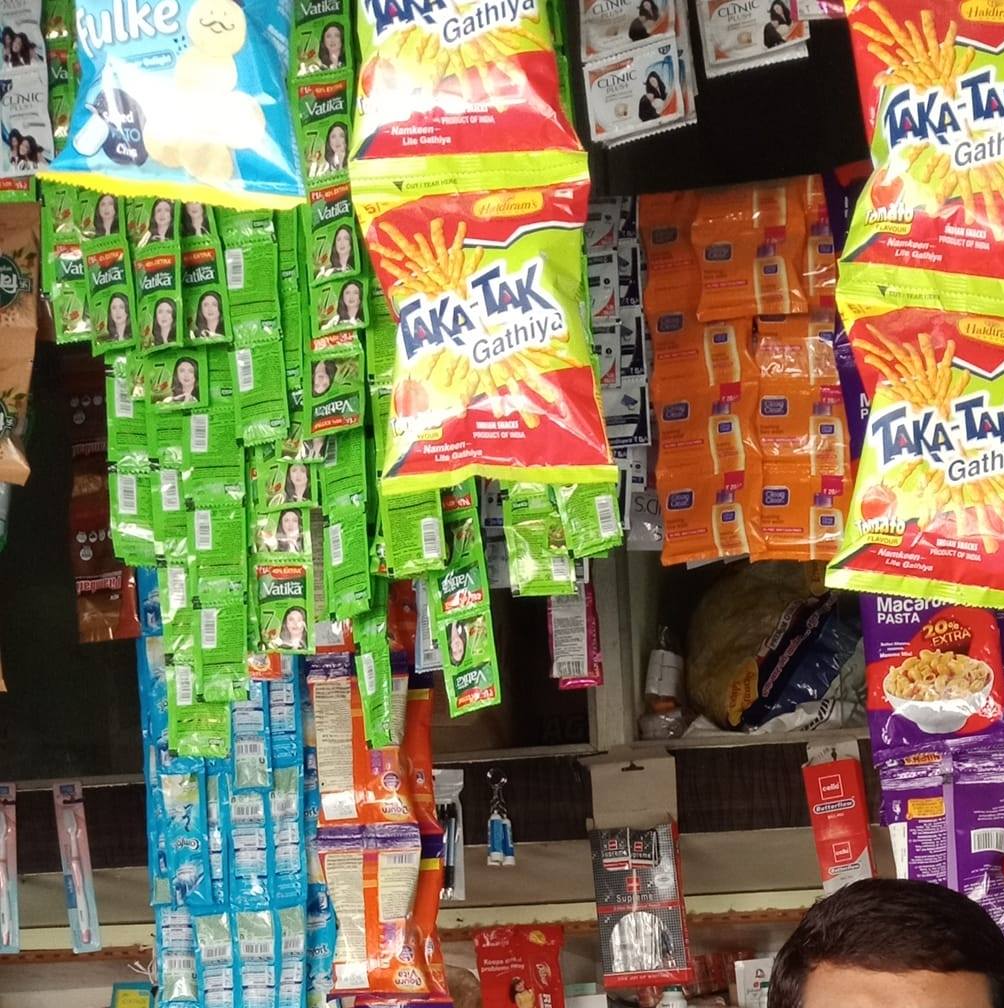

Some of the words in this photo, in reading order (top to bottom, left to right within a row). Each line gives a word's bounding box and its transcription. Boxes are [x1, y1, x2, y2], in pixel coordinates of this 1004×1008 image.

[301, 1, 340, 17] Vatika
[717, 2, 759, 18] CLINIC
[443, 0, 535, 43] Gathiya
[597, 72, 637, 90] CLINIC
[306, 100, 344, 116] Vatika
[391, 125, 434, 136] Namkeen
[419, 136, 451, 146] Gathiya
[317, 202, 350, 221] Vatika
[865, 202, 914, 225] Tomato
[887, 237, 929, 250] Namkeen
[912, 250, 942, 262] Gathiya
[91, 267, 123, 286] Vatika
[139, 273, 173, 291] Vatika
[400, 263, 557, 360] TAKA-TAK
[473, 312, 563, 364] Gathiya
[315, 399, 354, 416] Vatika
[856, 518, 905, 536] Tomato
[867, 535, 899, 545] FLAVOUR
[878, 548, 920, 561] Namkeen
[902, 560, 933, 572] Gathiya
[263, 582, 303, 596] Vatika
[877, 612, 921, 625] PASTA
[922, 619, 960, 639] 20%
[932, 629, 972, 646] EXTRA
[456, 669, 487, 686] Vatika
[816, 801, 852, 813] Butterflow
